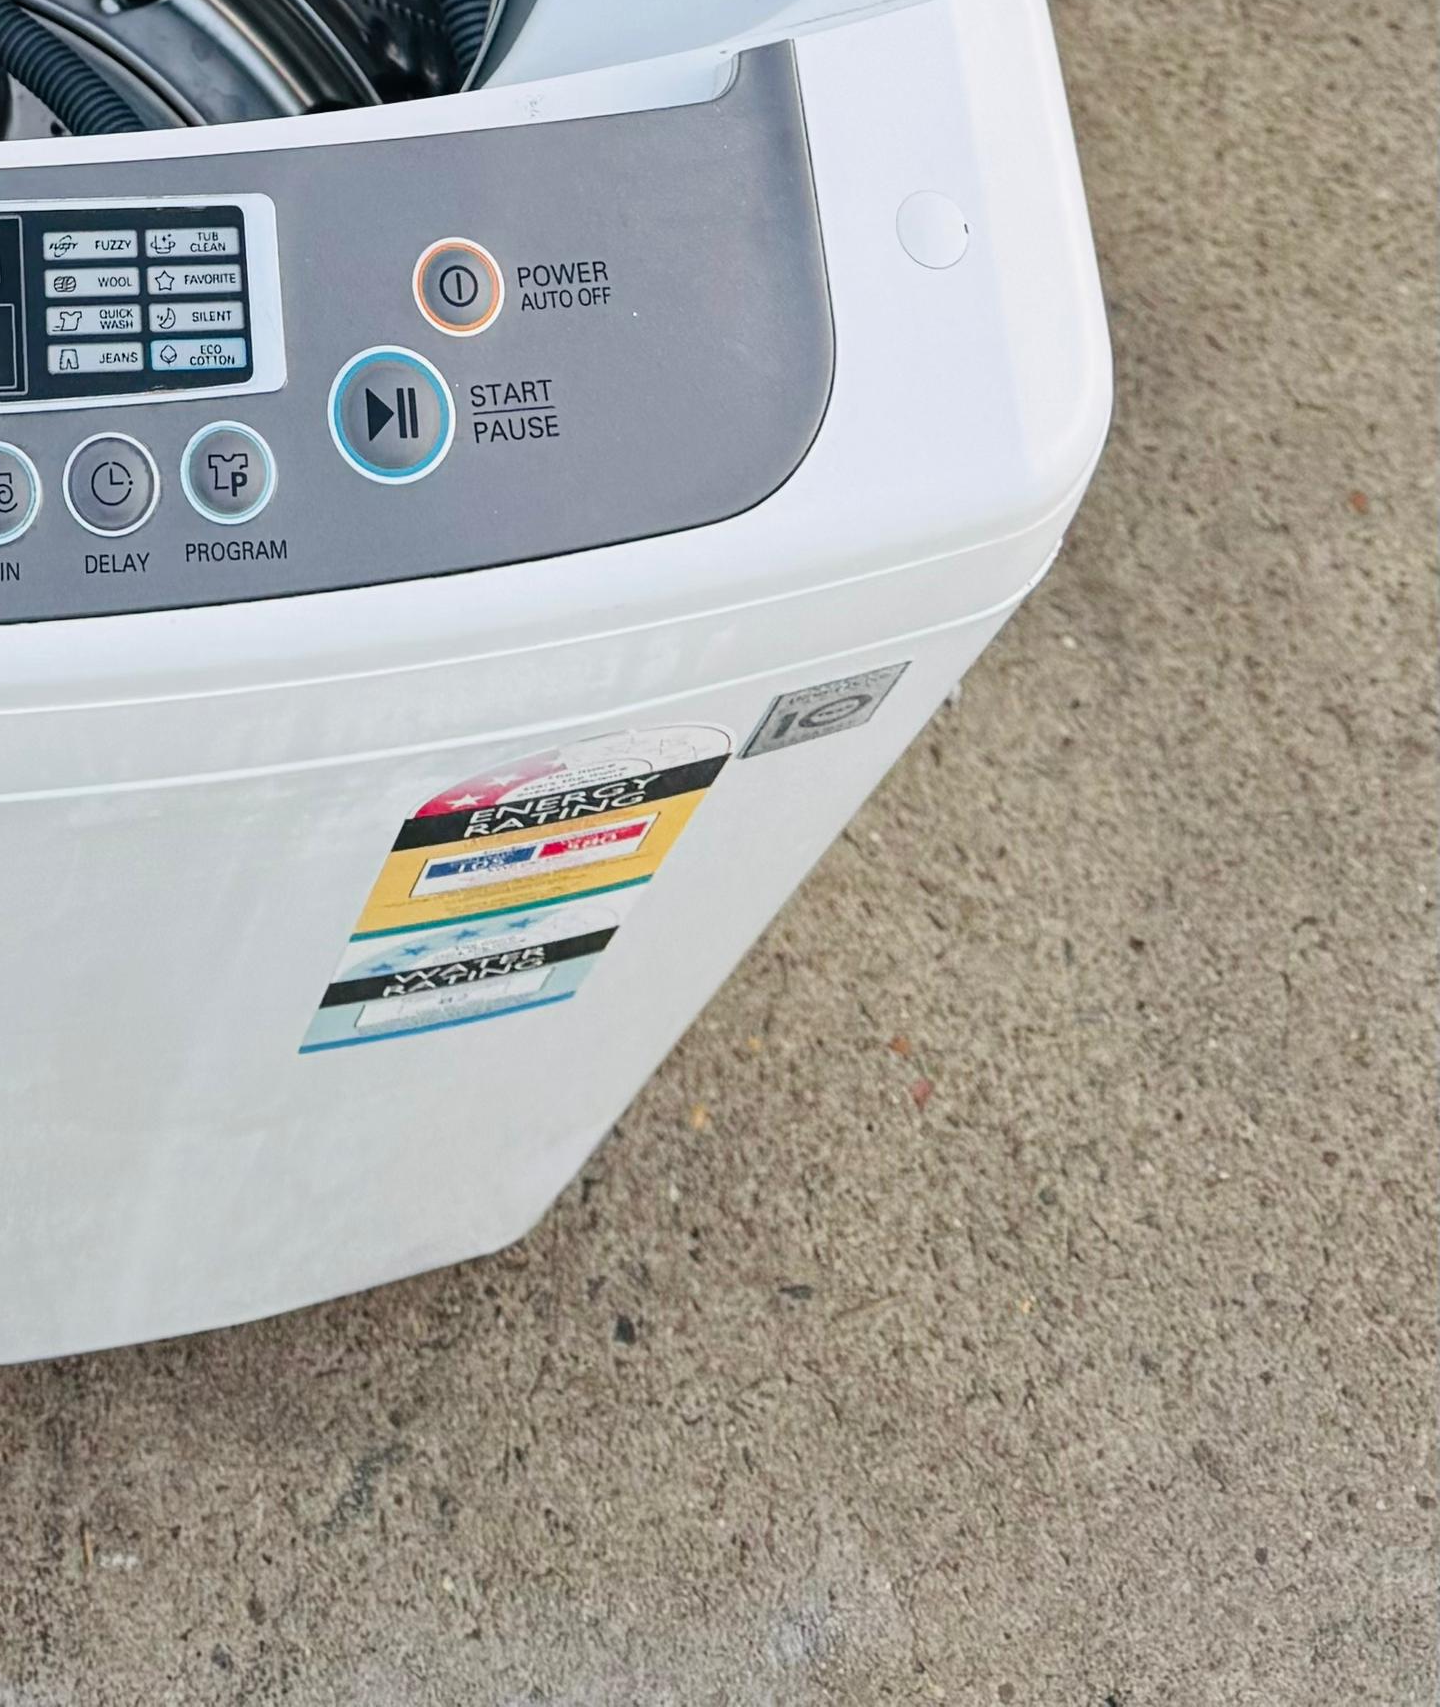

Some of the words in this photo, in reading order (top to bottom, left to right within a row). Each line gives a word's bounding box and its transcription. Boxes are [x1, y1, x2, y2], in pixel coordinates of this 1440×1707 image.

[197, 231, 219, 242] TUB
[94, 239, 132, 251] FUZZY
[189, 242, 227, 253] CLEAN
[183, 272, 237, 286] FAVORITE
[516, 260, 609, 288] POWER
[97, 276, 133, 288] WOOL
[520, 289, 574, 311] AUTO
[577, 286, 612, 307] OFF
[99, 308, 135, 320] QUICK
[191, 310, 233, 323] SILENT
[99, 319, 134, 330] WASH
[200, 344, 222, 355] ECO
[98, 353, 139, 364] JEANS
[189, 355, 236, 367] COTTON
[470, 379, 553, 408] START
[472, 414, 561, 444] PAUSE
[185, 539, 288, 563] PROGRAM
[84, 552, 150, 575] DELAY
[469, 773, 660, 826] ENERGY
[463, 791, 646, 839] RATING
[394, 946, 545, 983] WATER
[381, 958, 545, 998] RATING
